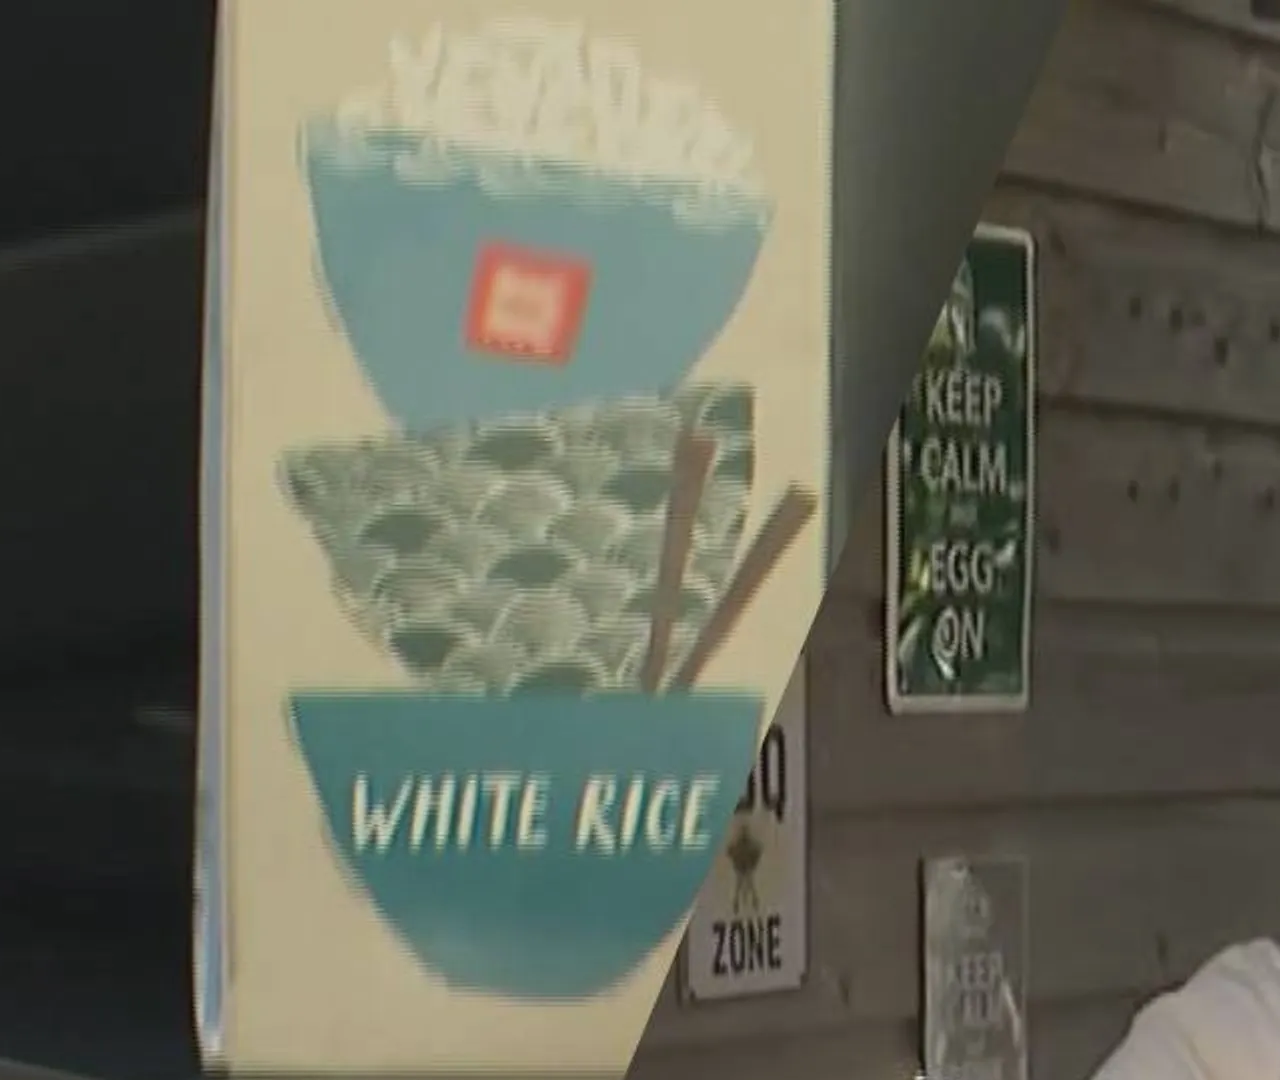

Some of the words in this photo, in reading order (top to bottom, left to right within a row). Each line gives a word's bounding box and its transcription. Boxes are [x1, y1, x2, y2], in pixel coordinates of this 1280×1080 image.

[925, 371, 1002, 424] KEEP
[922, 442, 1007, 494] CALM
[931, 540, 995, 594] EGG
[933, 607, 984, 660] ON
[352, 772, 550, 853] WHITE
[576, 772, 721, 856] RICE
[712, 914, 782, 976] ZONE
